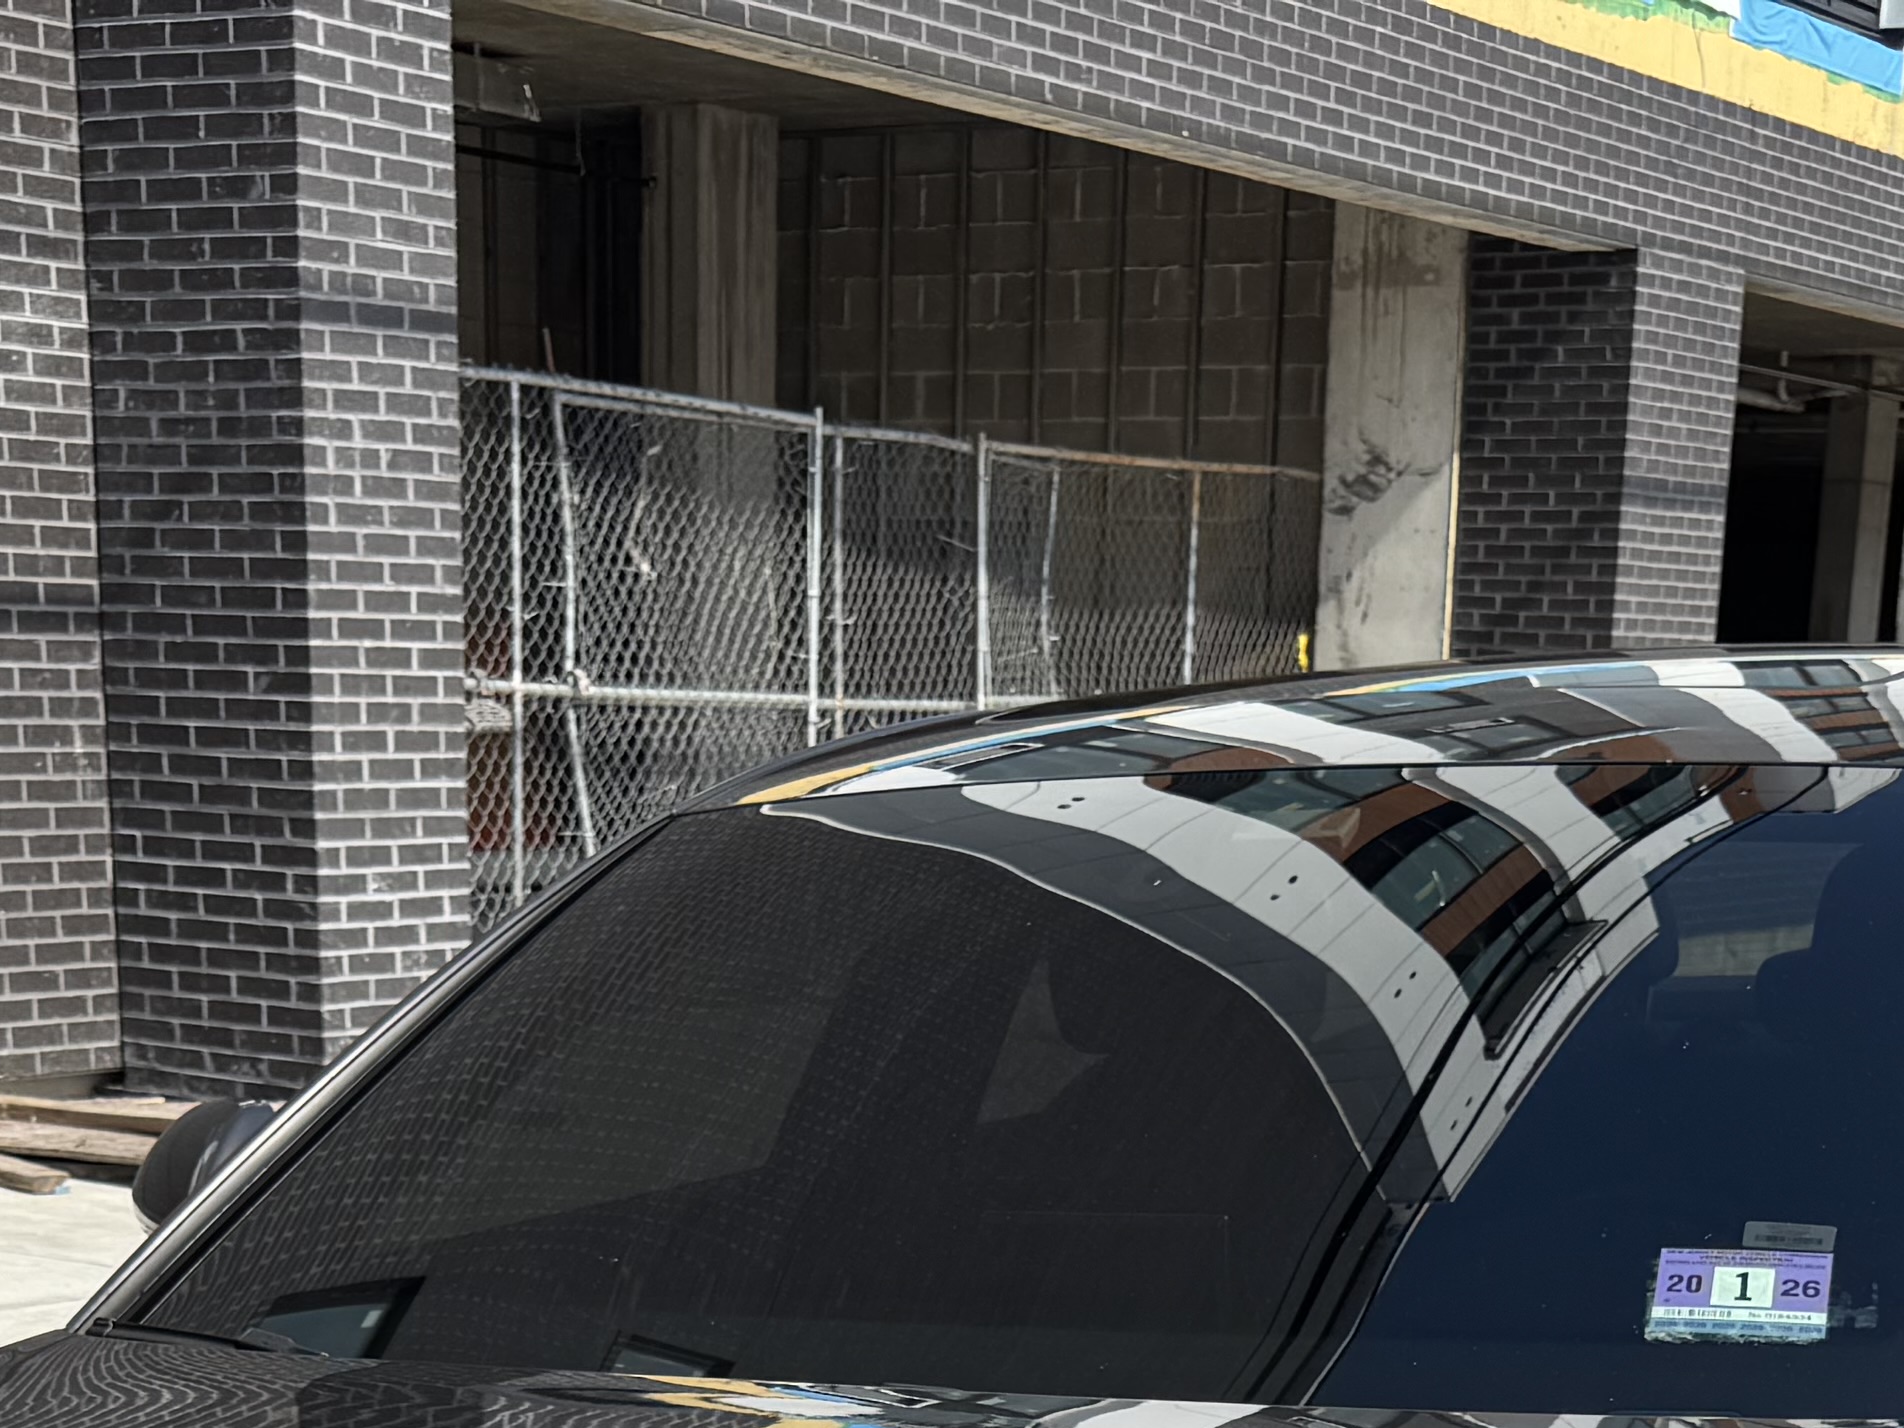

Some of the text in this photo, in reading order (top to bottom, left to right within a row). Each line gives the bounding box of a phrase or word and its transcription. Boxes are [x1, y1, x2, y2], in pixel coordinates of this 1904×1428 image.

[1666, 1271, 1821, 1302] 20 1 26
